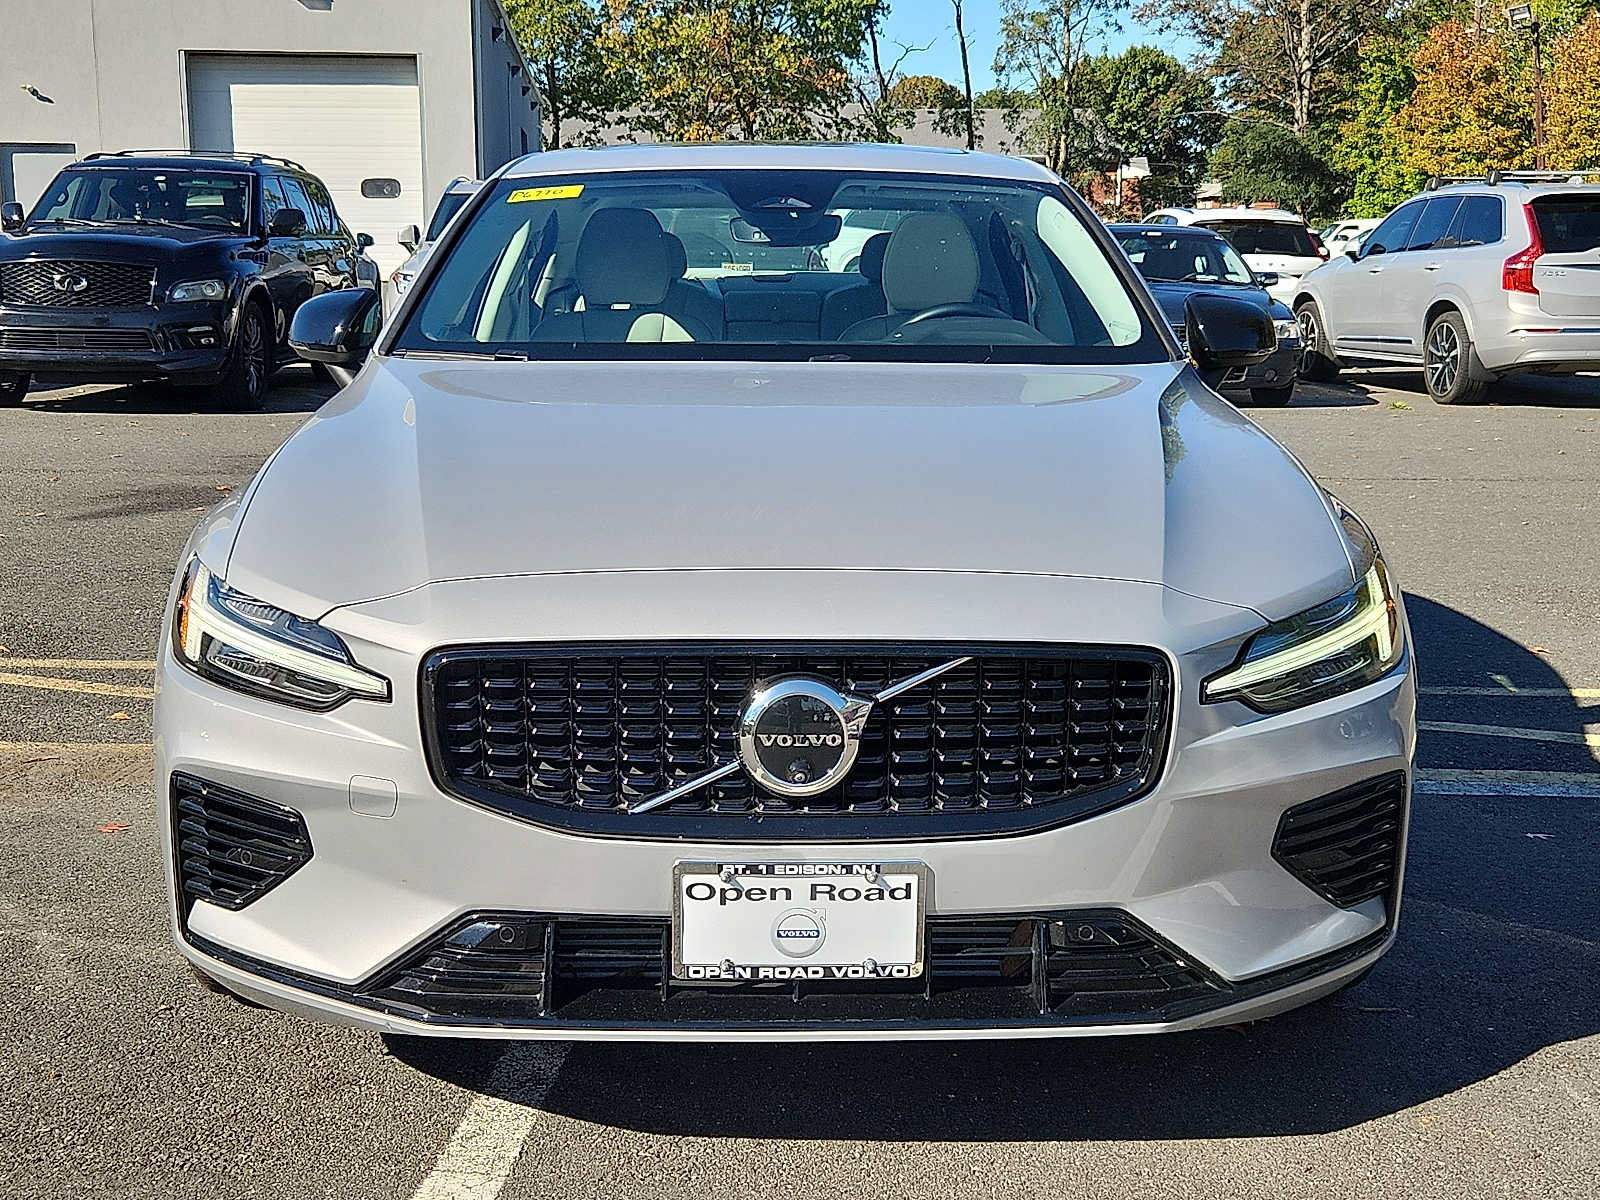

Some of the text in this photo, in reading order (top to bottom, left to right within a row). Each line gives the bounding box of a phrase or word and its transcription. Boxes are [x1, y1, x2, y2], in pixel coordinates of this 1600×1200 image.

[757, 734, 842, 747] VOLVO
[759, 864, 767, 875] 1
[685, 882, 912, 905] Open Road
[758, 966, 825, 978] ROAD
